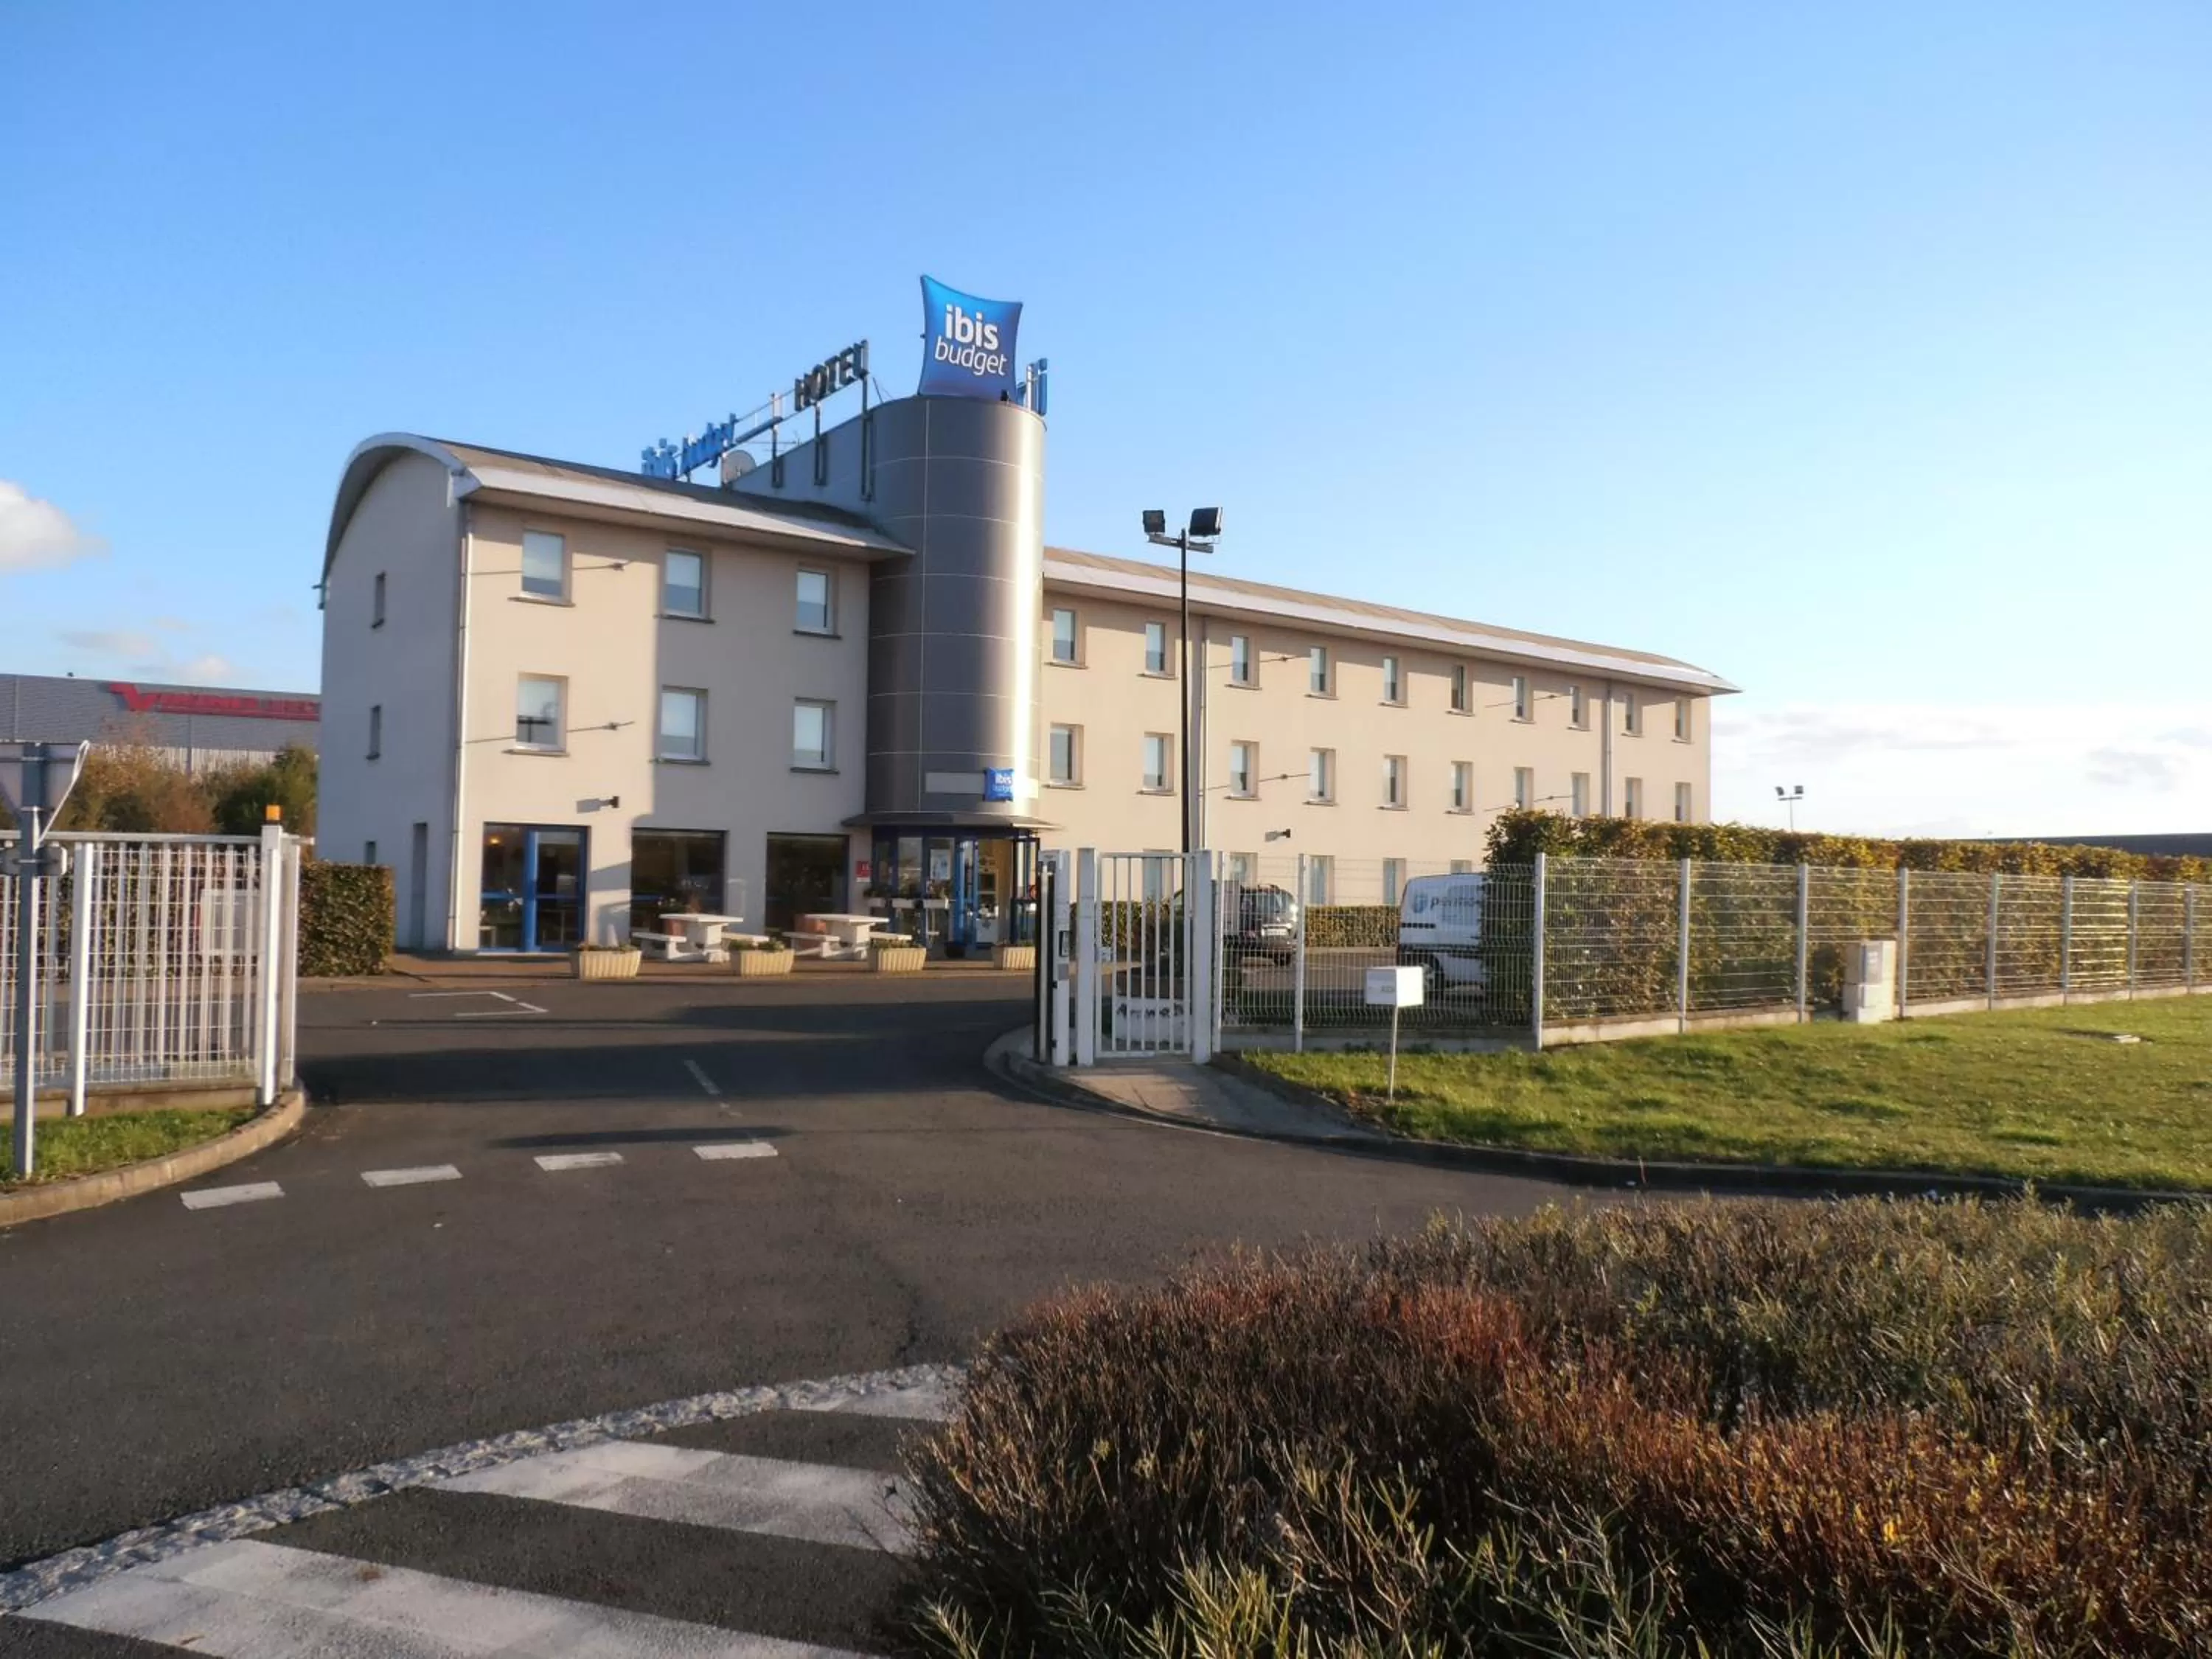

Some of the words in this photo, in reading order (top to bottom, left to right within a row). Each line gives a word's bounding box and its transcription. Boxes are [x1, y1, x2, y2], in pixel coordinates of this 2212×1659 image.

[945, 303, 999, 351] ibis
[795, 340, 868, 412] HOTEL
[934, 335, 1007, 376] budget
